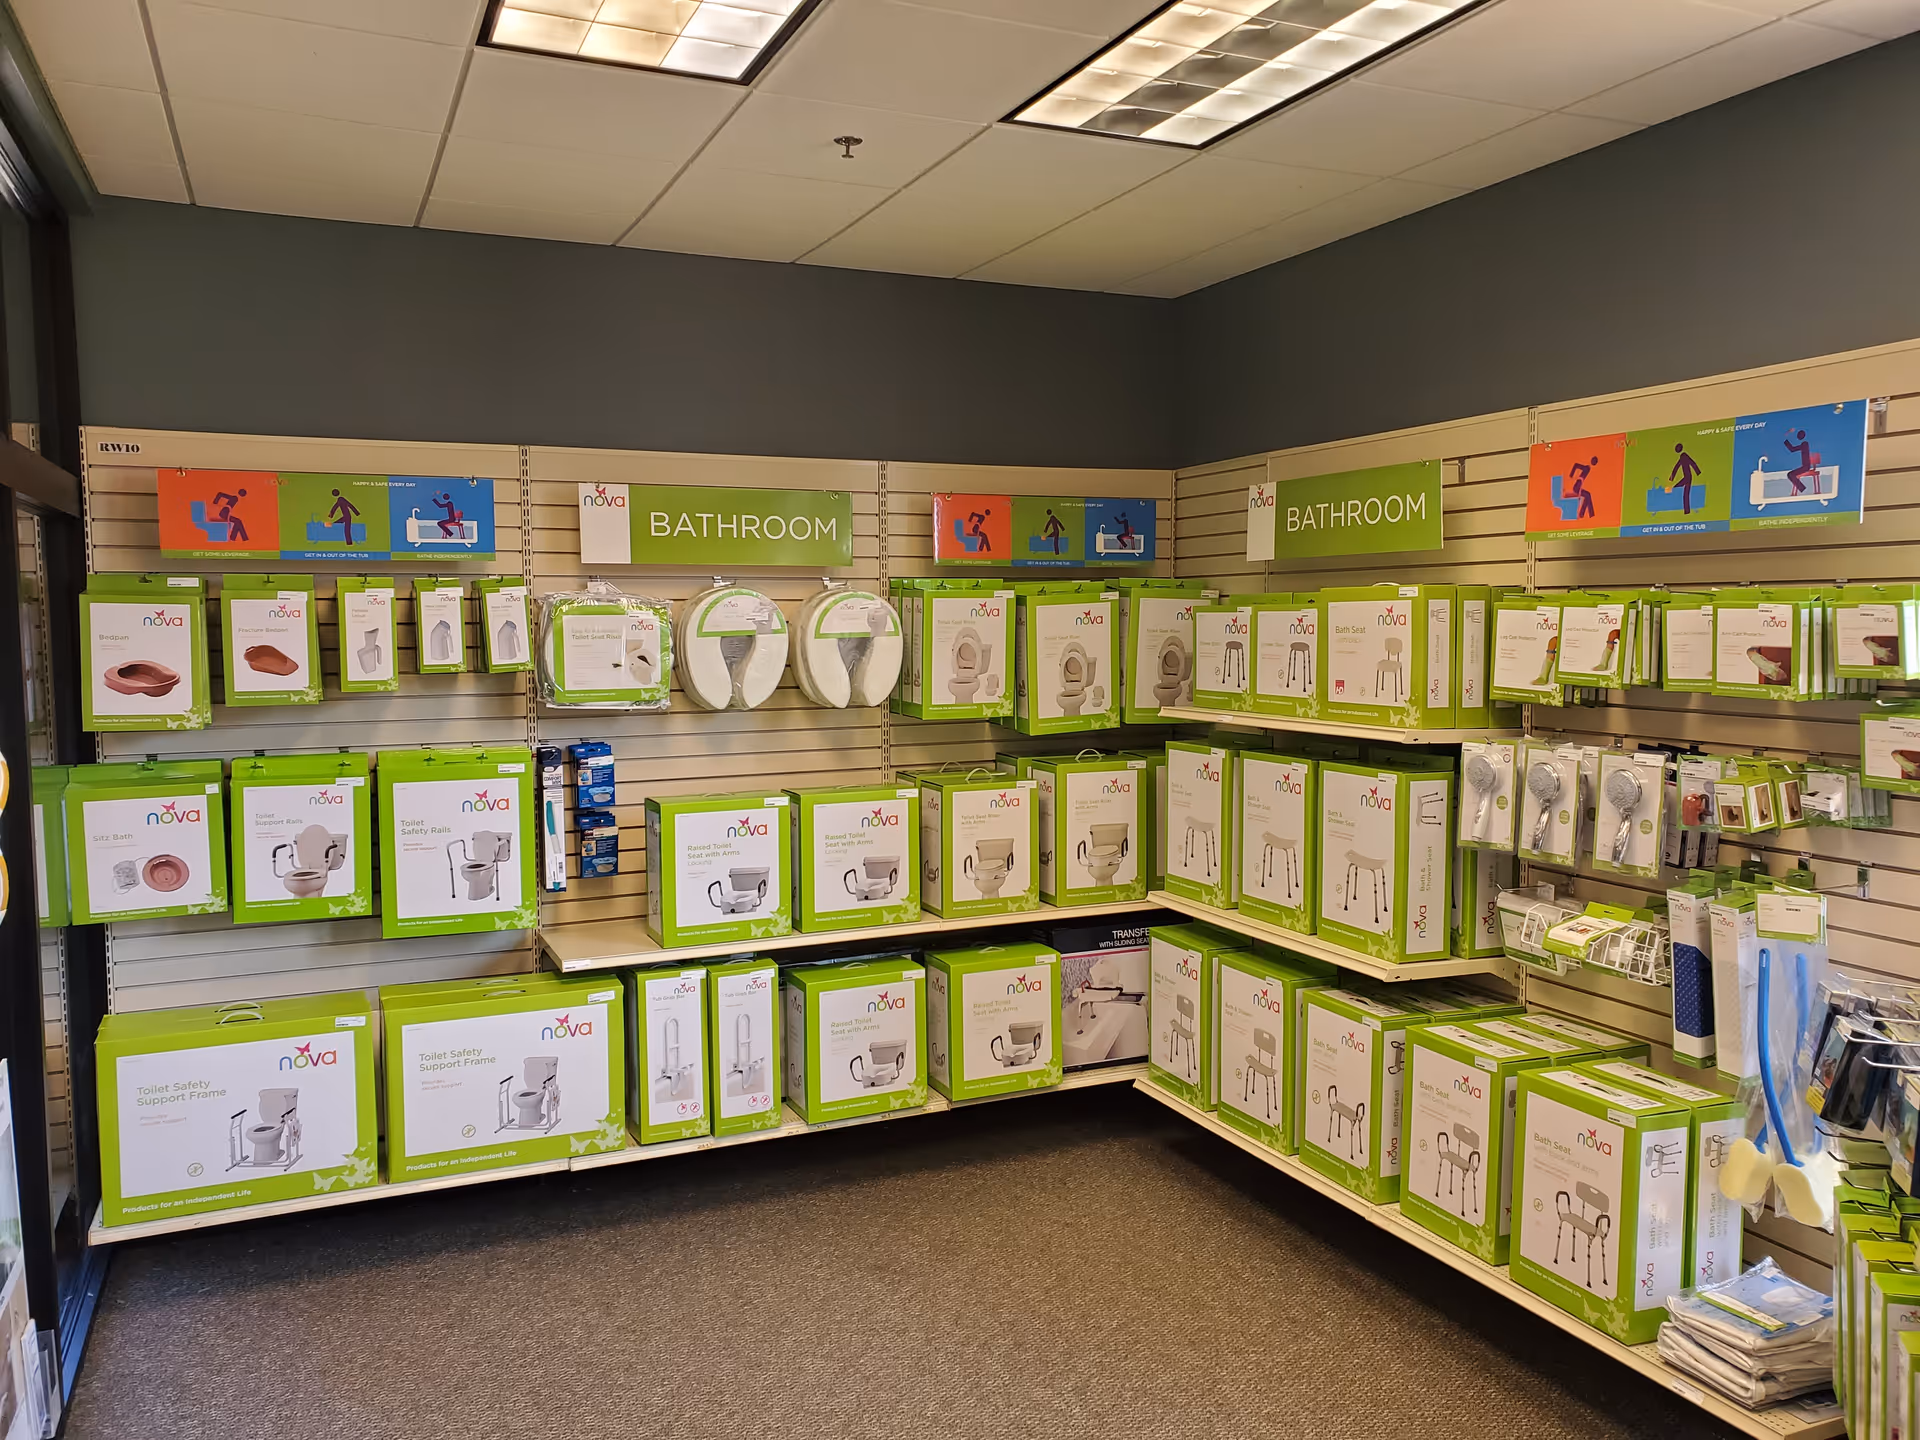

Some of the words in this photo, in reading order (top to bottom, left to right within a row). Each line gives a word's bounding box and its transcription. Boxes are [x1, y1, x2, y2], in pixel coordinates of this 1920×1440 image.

[1696, 428, 1714, 436] HAPPY
[1720, 425, 1734, 433] SAFE
[1735, 423, 1753, 431] EVERY
[1754, 421, 1766, 429] DAY
[99, 442, 140, 453] RW10
[583, 494, 626, 508] nova
[1250, 495, 1274, 509] nova
[1286, 491, 1426, 532] BATHROOM
[649, 510, 838, 541] BATHROOM
[1778, 516, 1828, 525] INDEPENDENTLY
[269, 607, 301, 618] nova
[970, 606, 1000, 618] nova
[1378, 612, 1407, 626] nova
[143, 614, 183, 627] nova
[1076, 614, 1103, 626] nova
[1536, 621, 1557, 631] nova
[1598, 616, 1618, 625] nova
[1763, 619, 1787, 628] nova
[1225, 623, 1248, 635] nova
[1290, 623, 1315, 635] nova
[1335, 626, 1350, 634] Bath
[1351, 625, 1366, 634] Seat
[1196, 768, 1220, 783] nova
[1102, 783, 1131, 795] nova
[1275, 780, 1302, 795] nova
[309, 794, 344, 805] nova
[462, 797, 510, 813] nova
[990, 797, 1020, 809] nova
[1360, 794, 1392, 811] nova
[146, 808, 200, 826] nova
[255, 818, 284, 826] Support
[400, 819, 425, 827] Toilet
[861, 814, 898, 828] nova
[112, 833, 133, 841] Bath
[401, 826, 429, 836] Safety
[431, 826, 452, 834] Rails
[727, 823, 768, 838] nova
[825, 833, 847, 841] Raised
[848, 831, 866, 839] Toilet
[687, 844, 711, 852] Raised
[712, 842, 732, 850] Toilet
[825, 841, 838, 849] Seat
[839, 839, 855, 847] with
[856, 838, 874, 846] Arms
[702, 850, 721, 858] with
[722, 849, 740, 857] Arms
[1674, 904, 1692, 913] nova
[1419, 904, 1427, 939] nova
[1486, 901, 1496, 935] nova
[1717, 918, 1735, 928] nova
[1111, 927, 1149, 941] TRANSFE
[1099, 940, 1113, 948] WITH
[1113, 939, 1133, 947] SLIDING
[1175, 962, 1198, 982] nova
[674, 985, 696, 995] nova
[745, 981, 767, 991] nova
[1006, 979, 1042, 995] nova
[867, 996, 906, 1013] nova
[1252, 993, 1281, 1014] nova
[830, 1020, 853, 1029] Raised
[854, 1017, 873, 1026] Toilet
[830, 1028, 845, 1036] Seat
[845, 1026, 862, 1034] with
[862, 1023, 880, 1032] Arms
[541, 1021, 593, 1041] nova
[1313, 1037, 1325, 1048] Bath
[1325, 1043, 1338, 1055] Seat
[1341, 1035, 1365, 1054] nova
[279, 1049, 337, 1071] nova
[419, 1051, 447, 1062] Toilet
[450, 1047, 483, 1060] Safety
[419, 1060, 461, 1073] Support
[464, 1054, 497, 1067] Frame
[137, 1084, 170, 1096] Toilet
[173, 1079, 211, 1093] Safety
[1418, 1080, 1435, 1094] Bath
[1434, 1088, 1450, 1101] Seat
[1453, 1078, 1482, 1100] nova
[137, 1094, 186, 1107] Support
[189, 1088, 227, 1101] Frame
[1390, 1136, 1398, 1165] nova
[1533, 1132, 1552, 1147] Bath
[1553, 1141, 1571, 1156] Seat
[1576, 1131, 1612, 1157] nova
[406, 1163, 437, 1172] Products
[461, 1152, 503, 1163] Independent
[504, 1150, 518, 1158] Life
[122, 1203, 158, 1214] Products
[160, 1201, 172, 1209] for
[185, 1191, 236, 1203] Independent
[237, 1189, 252, 1198] Life
[1706, 1250, 1714, 1284] nova
[1646, 1262, 1655, 1297] nova
